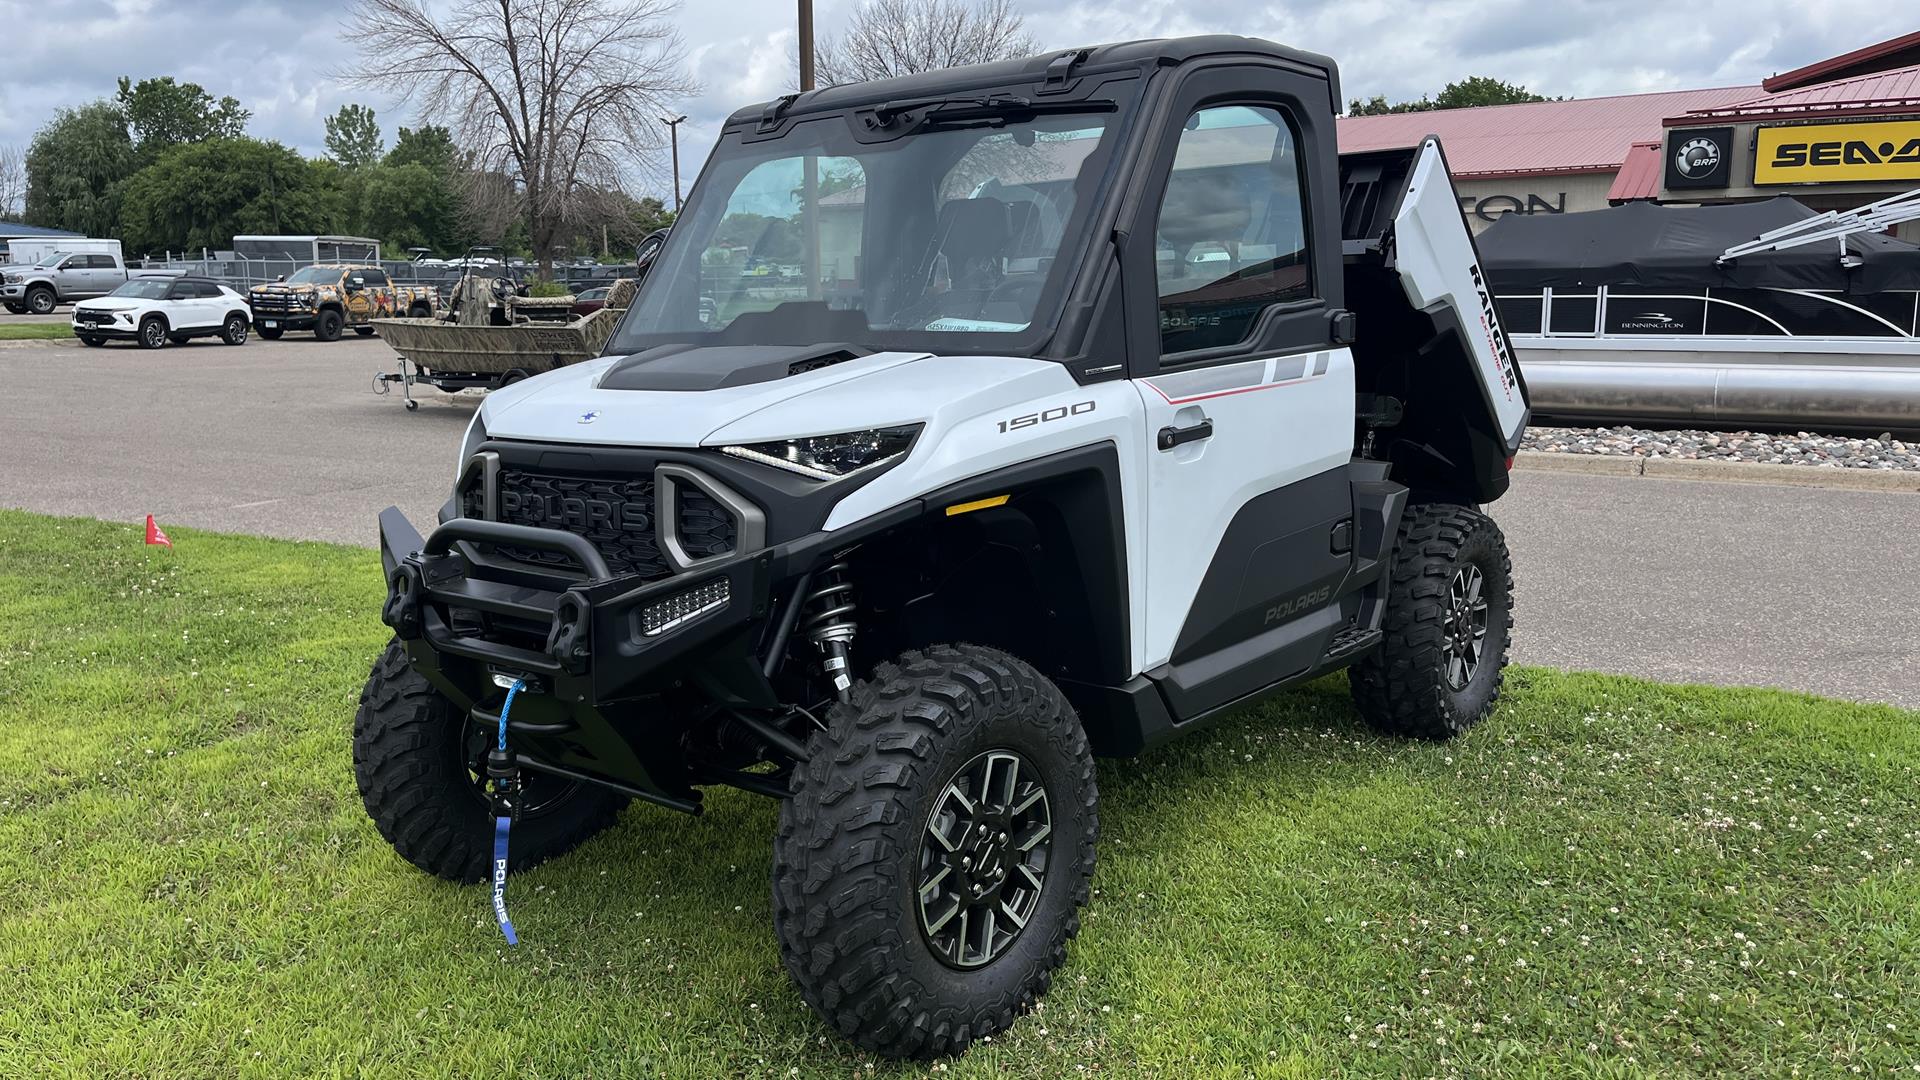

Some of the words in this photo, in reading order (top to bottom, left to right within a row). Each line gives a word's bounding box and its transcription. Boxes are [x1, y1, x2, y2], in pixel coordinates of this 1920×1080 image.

[1692, 158, 1717, 167] BRP
[1161, 316, 1221, 327] POLARIS
[1469, 264, 1515, 389] RANGER
[997, 400, 1096, 433] 1500
[501, 491, 649, 531] POLARIS
[1264, 585, 1330, 625] POLARIS
[494, 859, 508, 924] POLARIS
